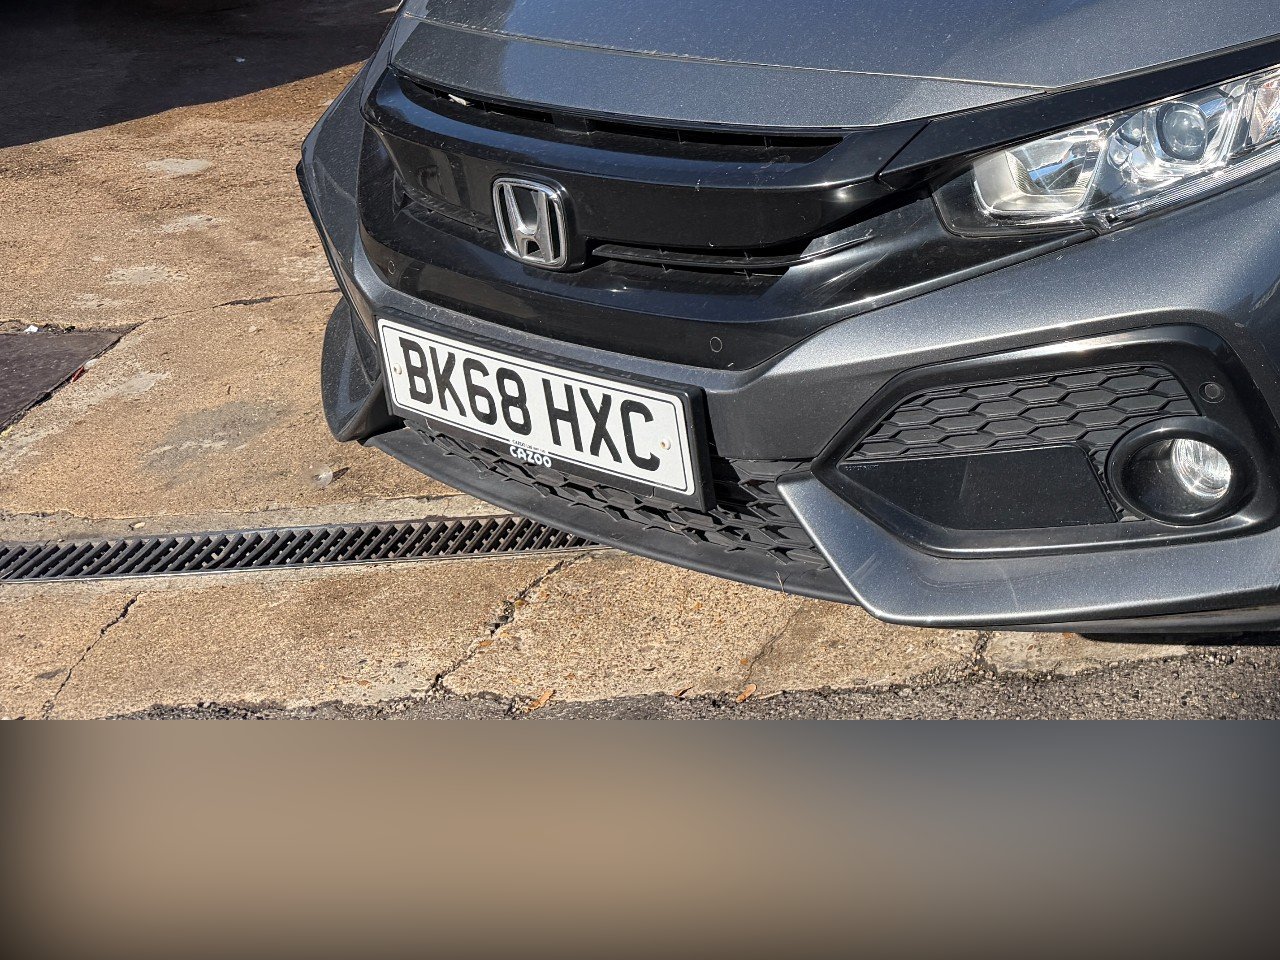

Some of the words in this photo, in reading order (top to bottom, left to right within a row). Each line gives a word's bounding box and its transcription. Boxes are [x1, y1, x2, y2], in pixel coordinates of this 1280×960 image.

[399, 336, 532, 436] BK68
[542, 378, 661, 472] HXC
[510, 445, 552, 468] CAZOO
